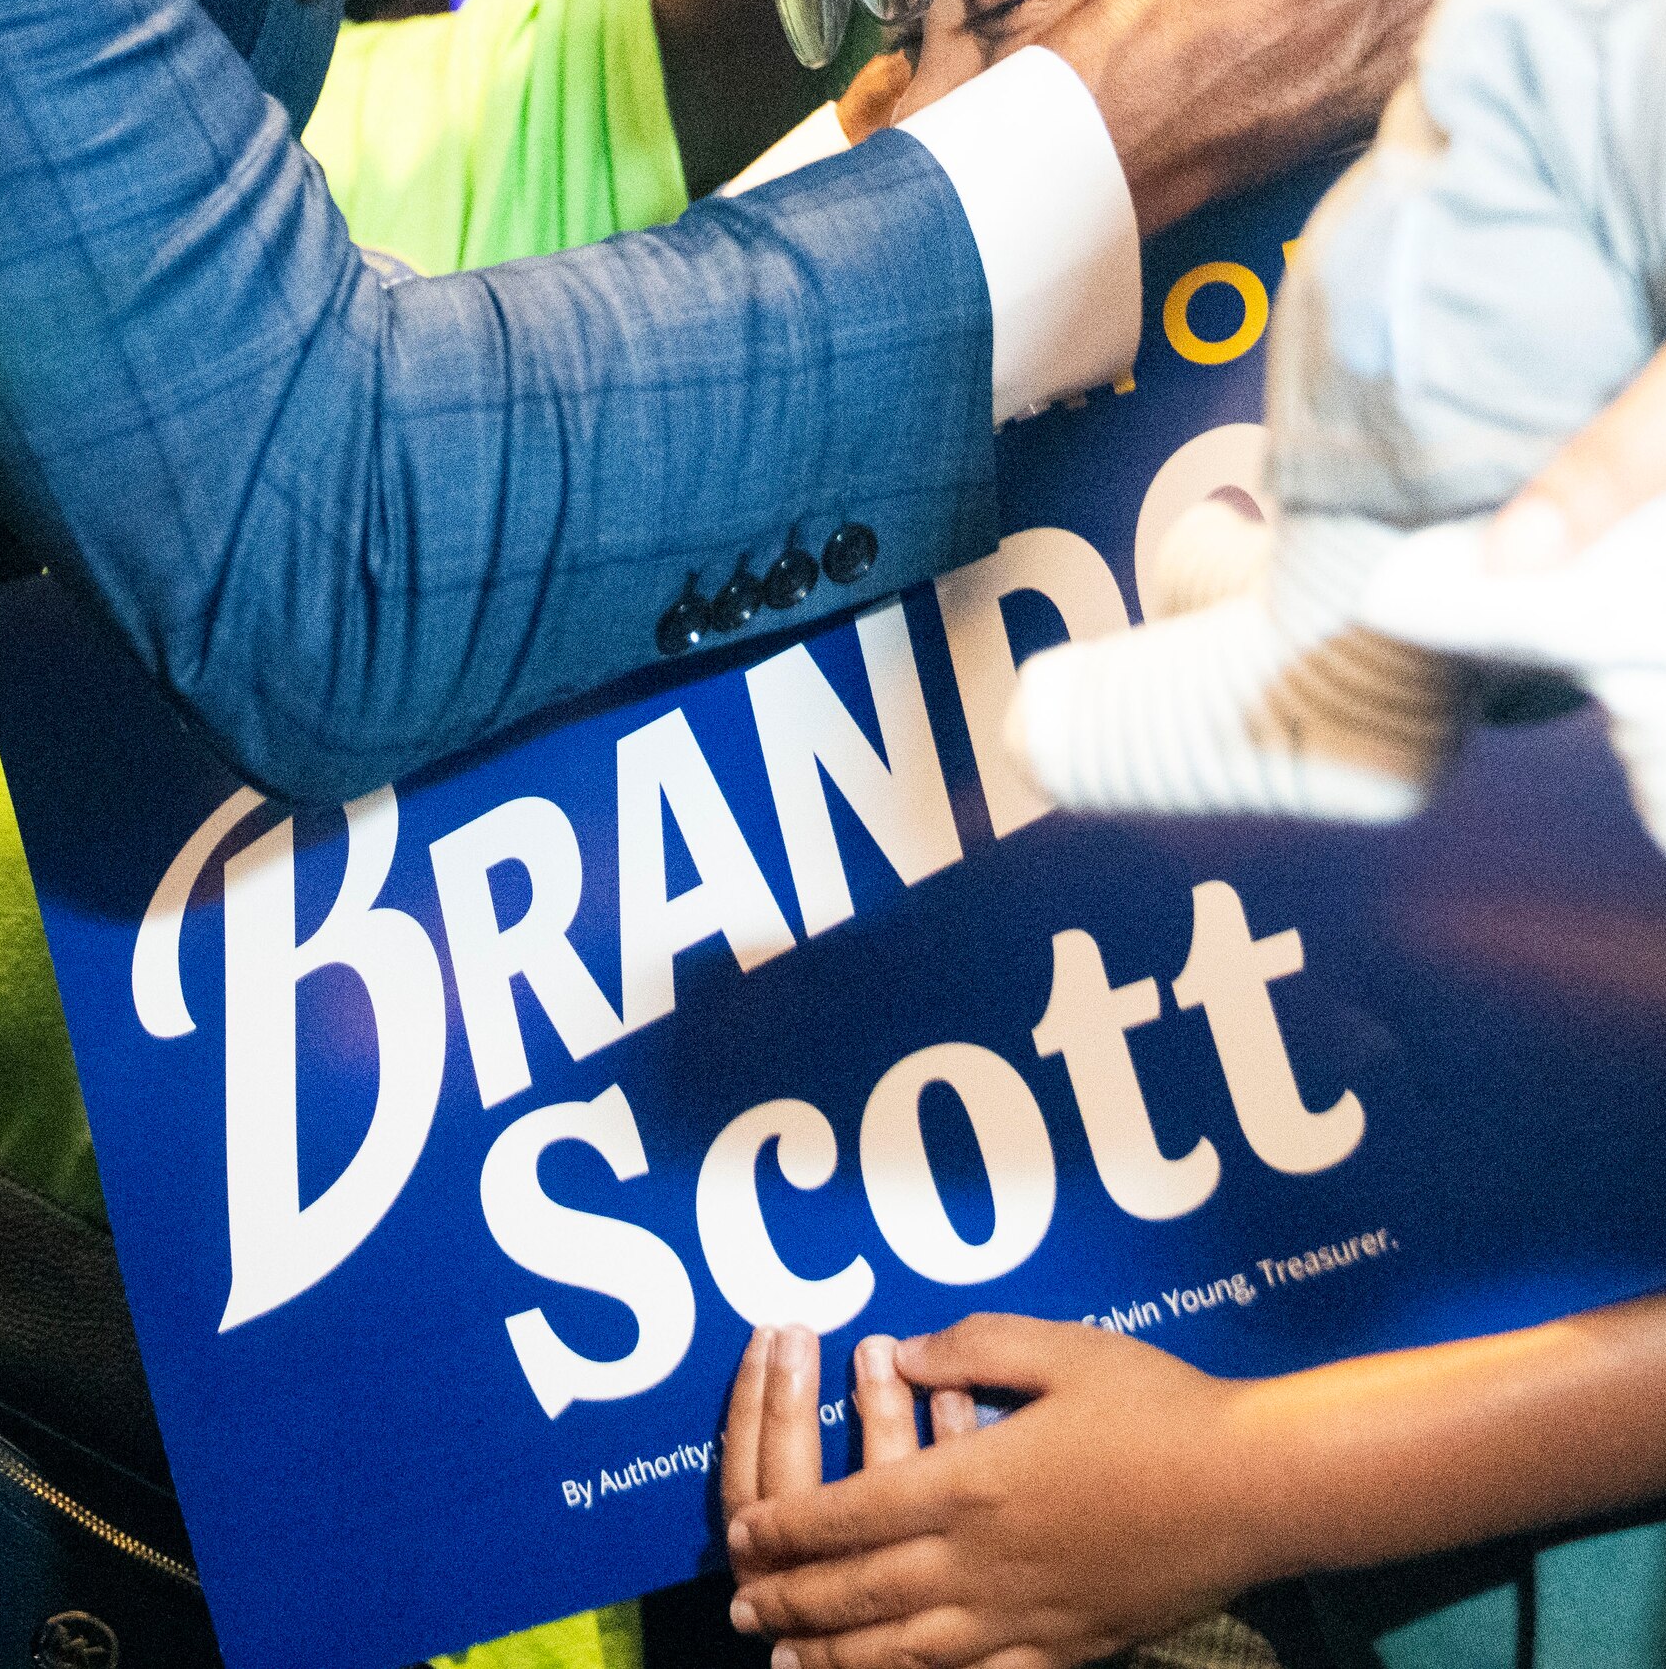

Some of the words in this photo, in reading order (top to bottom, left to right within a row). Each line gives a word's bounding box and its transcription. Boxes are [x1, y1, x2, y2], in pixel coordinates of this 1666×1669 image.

[131, 423, 1270, 1334] BRAND
[479, 879, 1366, 1421] Scott
[561, 1479, 593, 1510] By
[819, 1397, 846, 1427] or
[1161, 1272, 1258, 1318] Young,
[1257, 1226, 1401, 1289] Treasurer.
